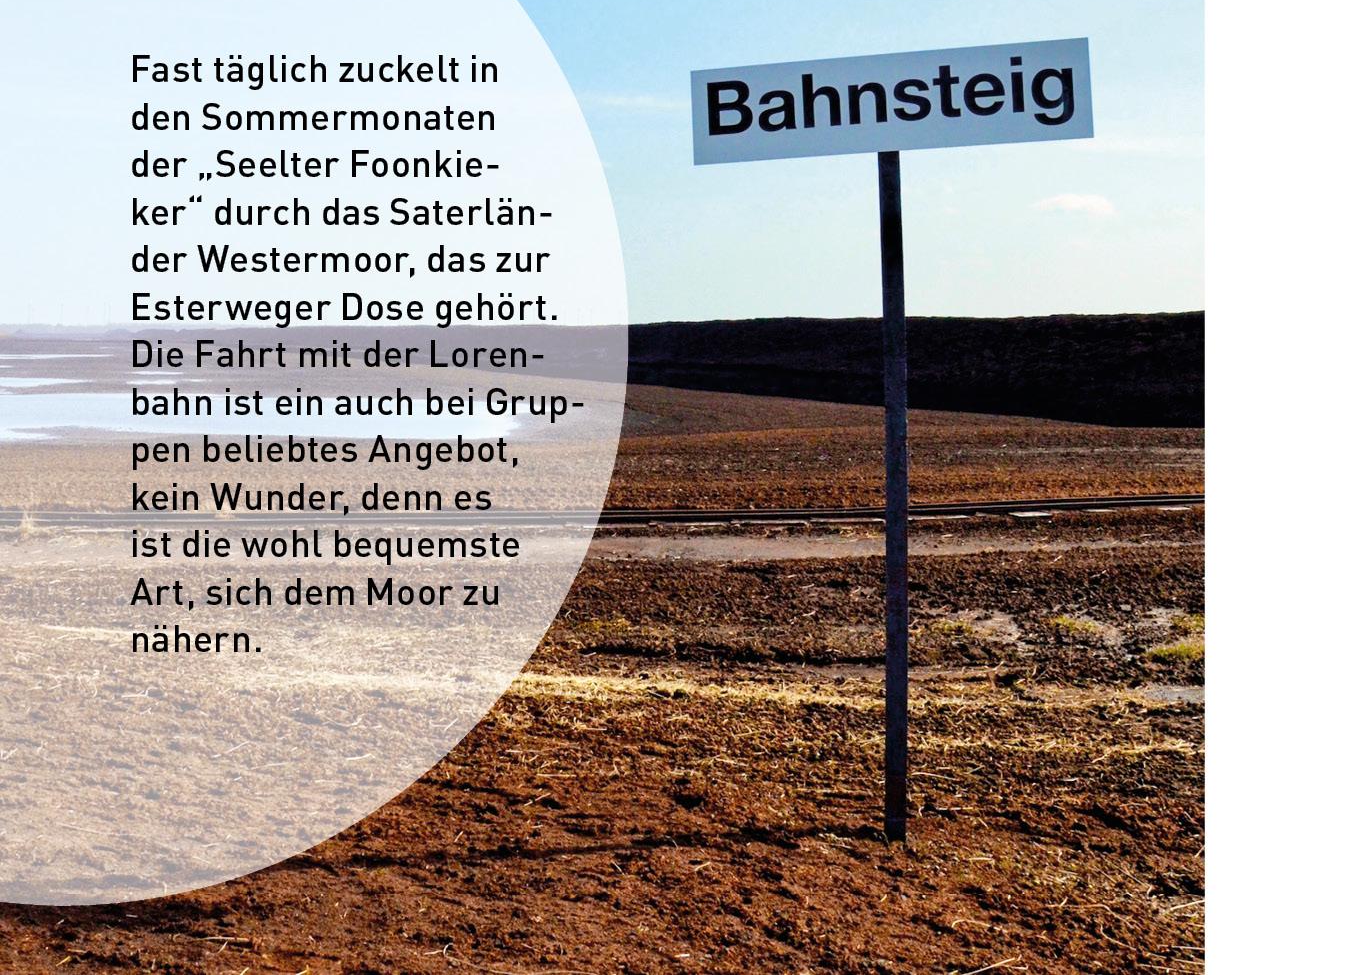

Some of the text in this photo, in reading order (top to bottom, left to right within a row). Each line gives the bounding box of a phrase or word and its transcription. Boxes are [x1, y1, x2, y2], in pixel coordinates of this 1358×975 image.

[133, 55, 497, 90] Fast täglich zuckelt in
[707, 57, 1074, 135] Bahnsteig
[132, 103, 494, 130] den Sommermonaten
[132, 150, 498, 180] der „Seelter Foonkie-
[133, 196, 551, 225] ker“ durch das Saterlän-
[132, 245, 550, 277] der Westermoor, das zur
[133, 293, 556, 328] Esterweger Dose gehört.
[133, 340, 543, 367] Die Fahrt mit der Loren-
[133, 388, 583, 423] bahn ist ein auch bei Grup-
[133, 435, 517, 470] pen beliebtes Angebot,
[133, 483, 491, 515] kein Wunder, denn es
[133, 530, 519, 565] ist die wohl bequemste
[131, 578, 498, 610] Art, sich dem Moor zu
[133, 625, 260, 652] nähern.
